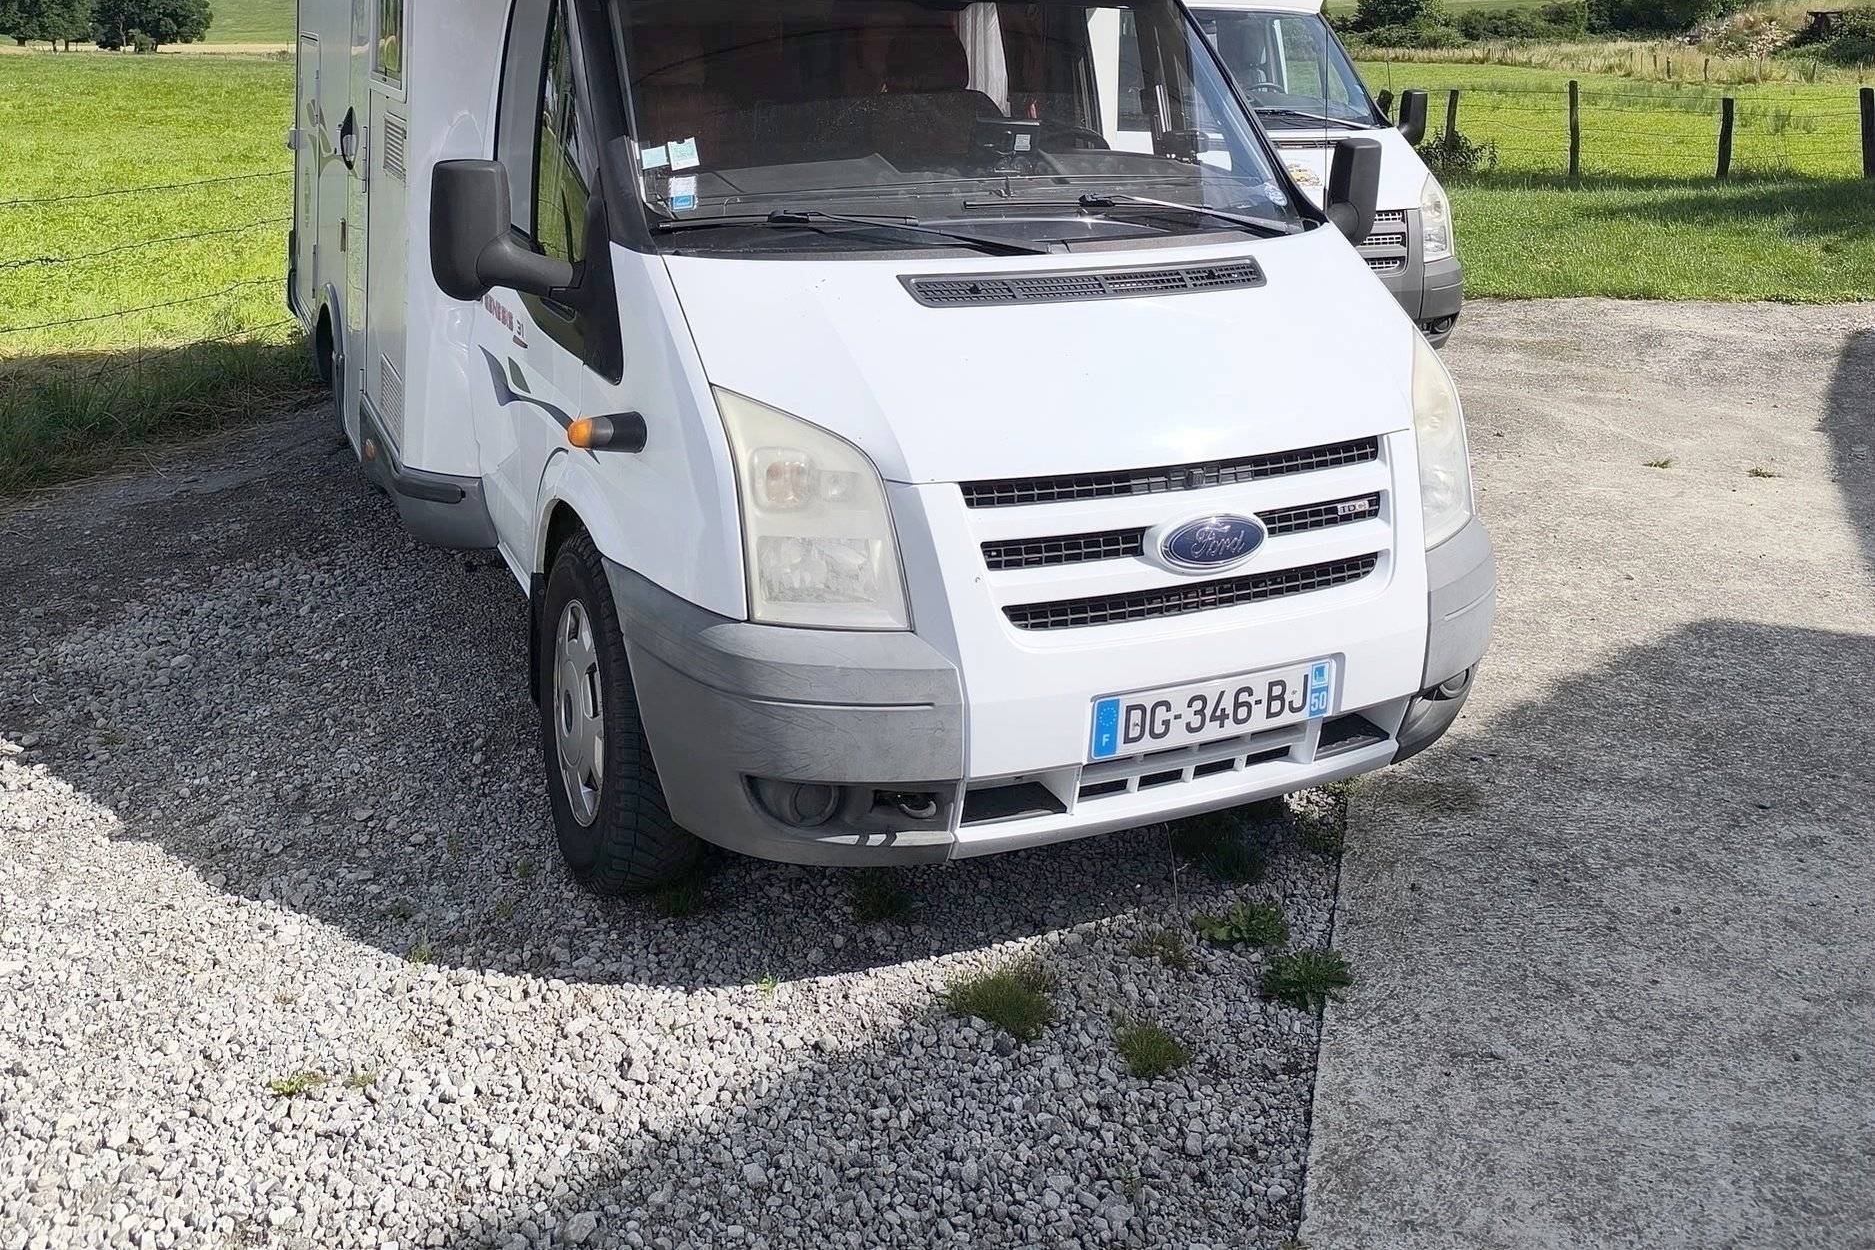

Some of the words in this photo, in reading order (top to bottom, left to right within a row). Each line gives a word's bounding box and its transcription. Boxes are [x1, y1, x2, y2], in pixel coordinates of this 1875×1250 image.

[1190, 526, 1245, 558] Ford
[1123, 674, 1309, 744] DG-346-BJ
[1310, 691, 1327, 711] 50
[1101, 734, 1110, 747] F
